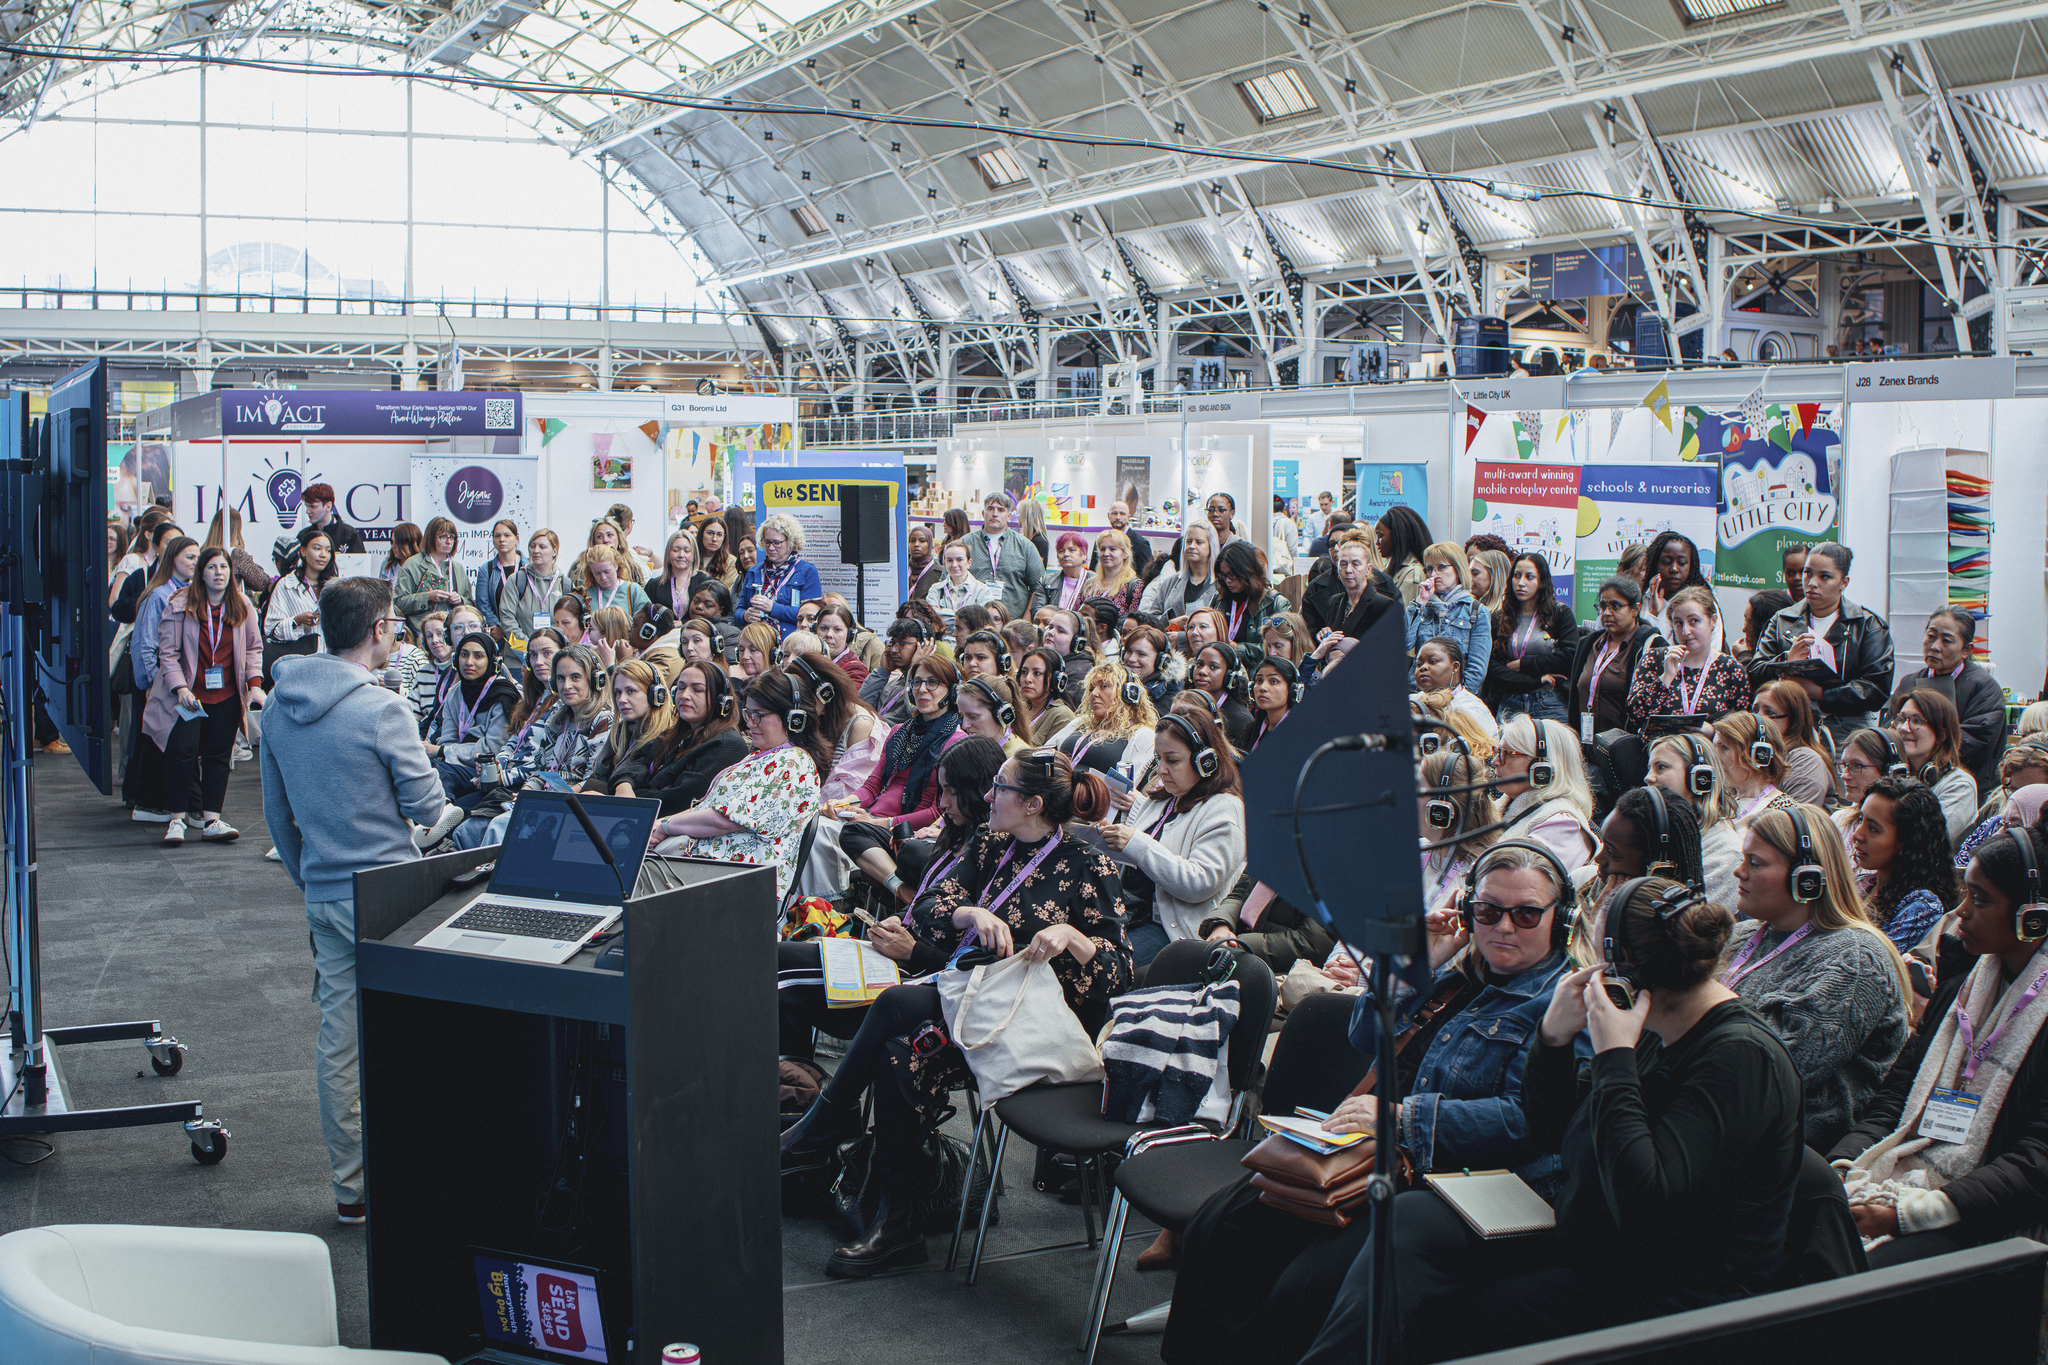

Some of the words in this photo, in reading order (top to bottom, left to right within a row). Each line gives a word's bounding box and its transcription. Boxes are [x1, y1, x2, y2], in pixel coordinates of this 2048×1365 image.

[1856, 376, 1871, 387] J28
[1879, 376, 1906, 386] Zenex
[1907, 374, 1939, 386] Brands
[1473, 391, 1487, 400] Little
[1488, 390, 1500, 400] City
[1501, 390, 1511, 399] UK
[671, 404, 685, 412] G31
[689, 404, 714, 412] Boromi
[716, 404, 727, 412] Ltd
[1199, 404, 1210, 412] SING
[1210, 404, 1220, 412] AND
[1484, 468, 1538, 480] multi-award
[1540, 469, 1574, 482] winning
[774, 484, 793, 500] the
[1477, 482, 1507, 494] mobile
[1510, 482, 1548, 497] roleplay
[1550, 484, 1578, 494] centre
[1587, 480, 1634, 492] schools
[1638, 481, 1648, 492] &
[1651, 482, 1711, 494] nurseries
[1368, 498, 1408, 507] Award-Winning
[1360, 512, 1380, 521] Speech
[1722, 504, 1776, 539] LITTLE
[1784, 501, 1829, 522] CITY
[487, 1270, 504, 1296] Big
[564, 1290, 576, 1310] the
[549, 1284, 570, 1340] SEND
